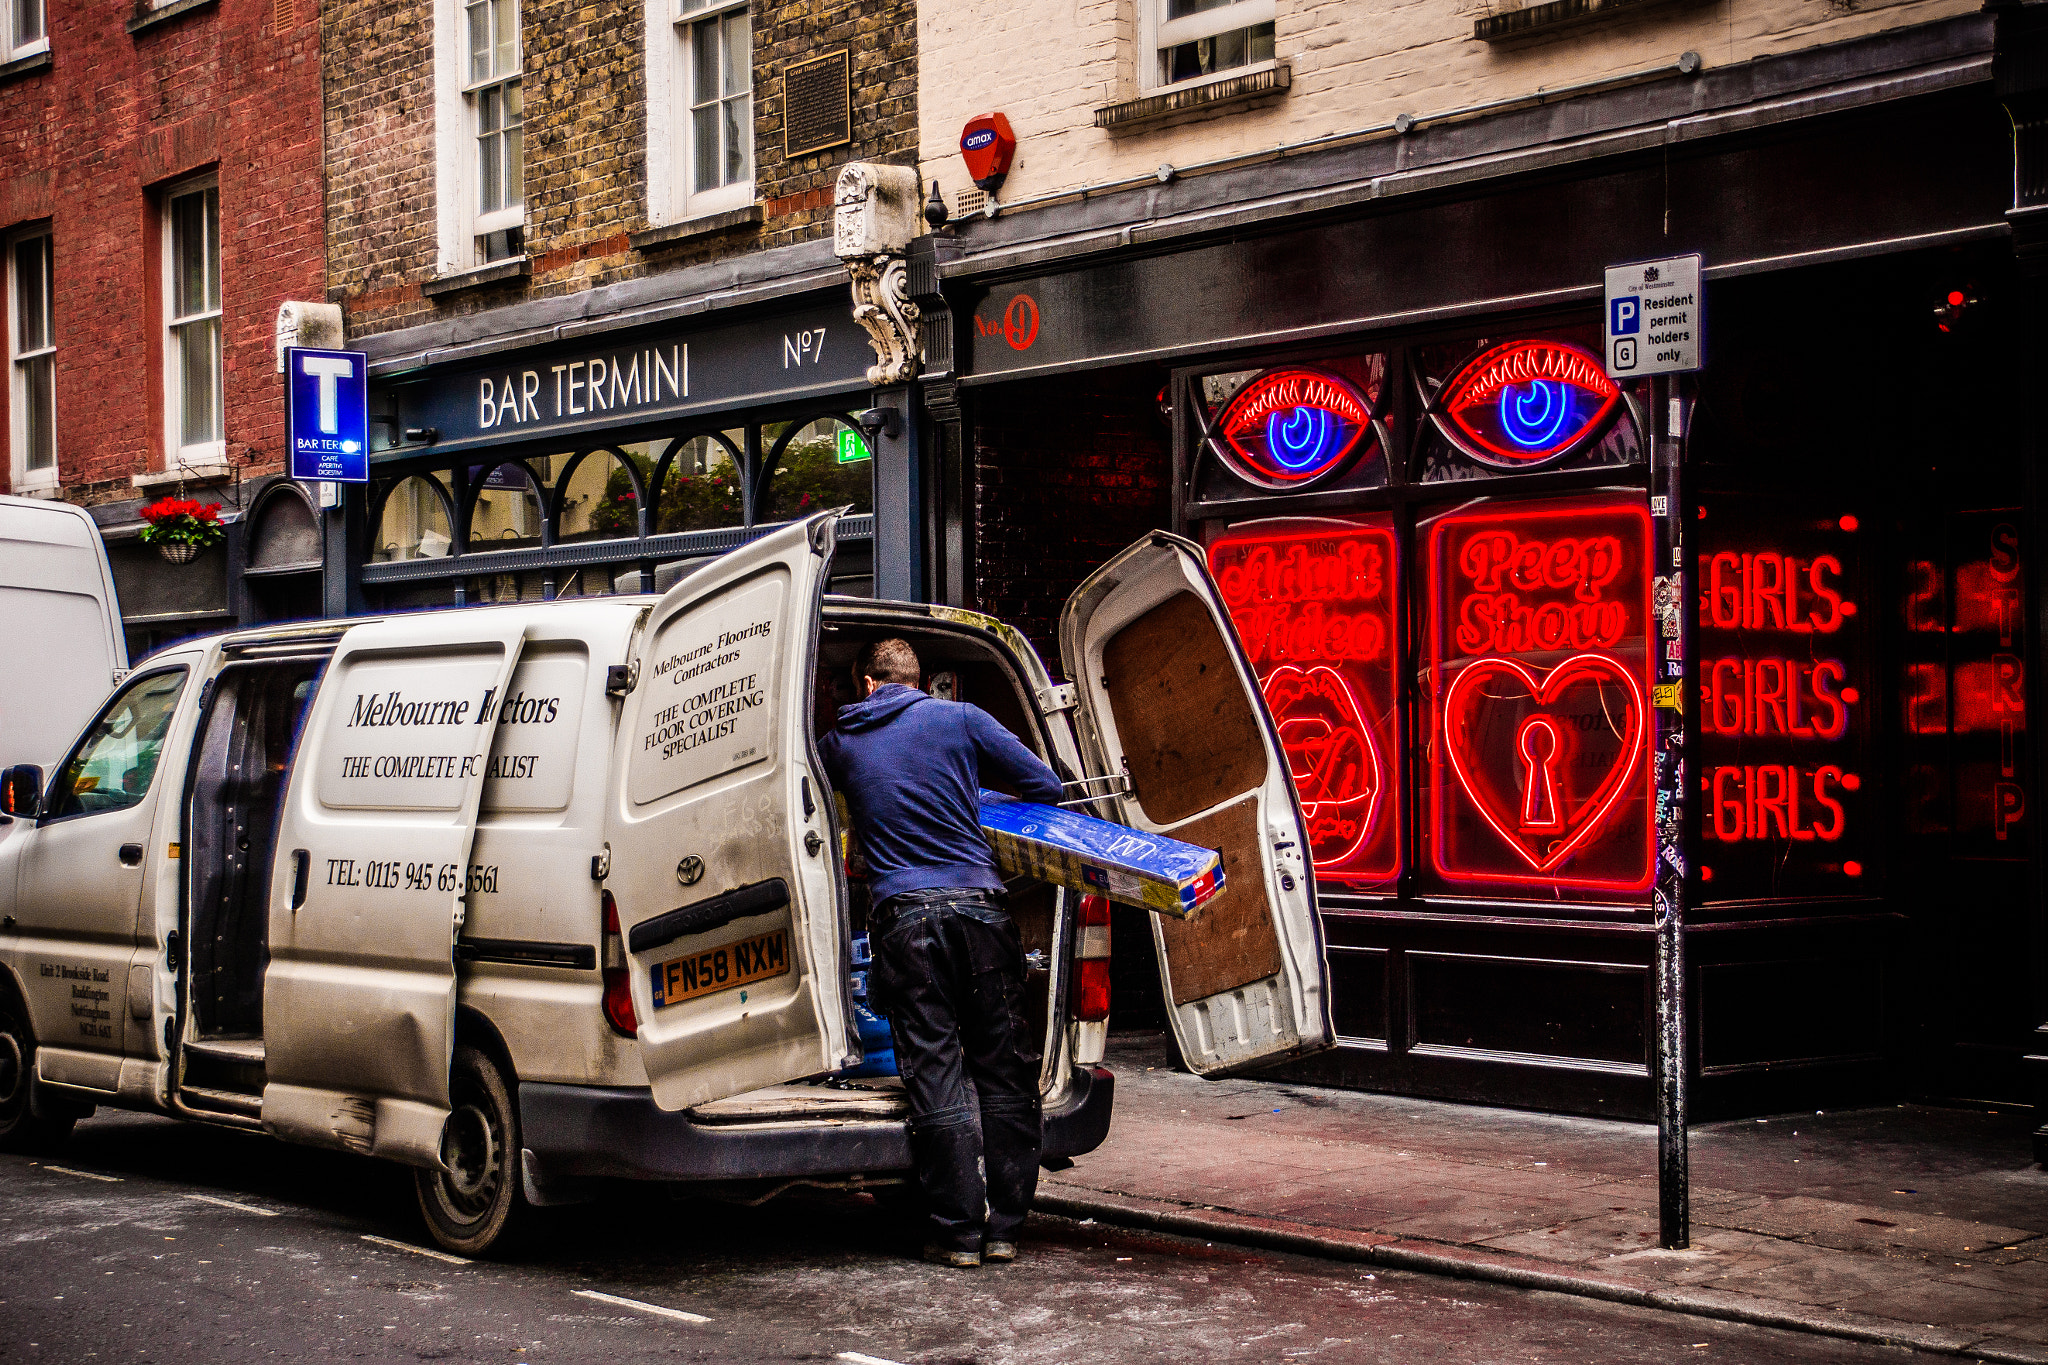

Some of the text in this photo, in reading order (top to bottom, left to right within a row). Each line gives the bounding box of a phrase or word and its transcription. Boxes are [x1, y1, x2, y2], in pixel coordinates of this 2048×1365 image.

[967, 132, 992, 147] amax
[1618, 301, 1635, 332] P
[1644, 293, 1694, 311] Resident
[1650, 311, 1687, 329] permit
[1620, 347, 1630, 361] G
[1648, 331, 1690, 345] holders
[1656, 348, 1681, 362] only
[303, 356, 354, 435] T
[480, 342, 690, 429] BAR TERMINI
[297, 438, 319, 450] BAR
[1459, 530, 1622, 602] Peep
[1710, 552, 1843, 634] GIRLS
[1456, 592, 1629, 655] Show
[653, 620, 772, 679] Melbourne Flooring
[673, 649, 741, 685] Contractors
[347, 690, 470, 728] Melbourne
[654, 673, 757, 728] THE COMPLETE
[1712, 657, 1846, 738] GIRLS
[644, 690, 765, 751] FLOOR COVERING
[662, 717, 738, 761] SPECIALIST
[341, 755, 372, 778] THE
[374, 755, 458, 778] COMPLETE
[1713, 765, 1845, 842] GIRLS
[327, 858, 362, 887] TEL:
[365, 860, 401, 888] 0115
[405, 862, 434, 891] 945
[666, 949, 730, 997] FN58
[735, 933, 785, 978] NXM
